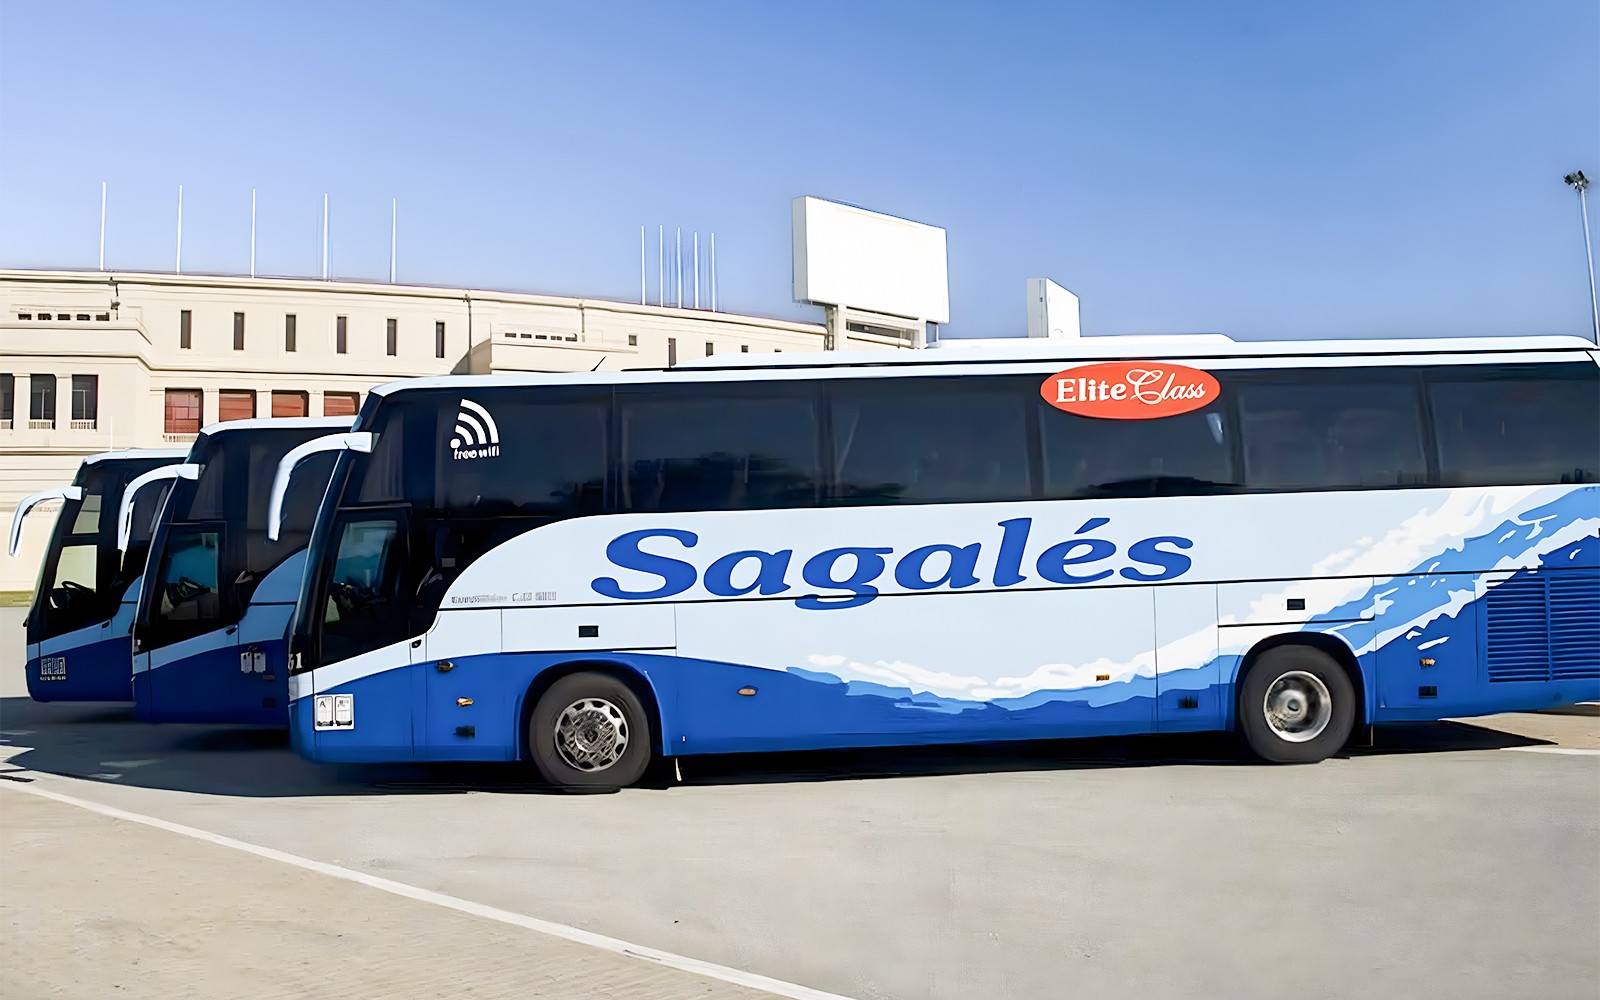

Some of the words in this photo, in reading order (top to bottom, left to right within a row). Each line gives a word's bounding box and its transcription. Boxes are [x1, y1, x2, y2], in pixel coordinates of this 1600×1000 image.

[1056, 377, 1127, 403] Elite
[1125, 369, 1206, 405] Class
[591, 517, 1194, 610] Sagalés
